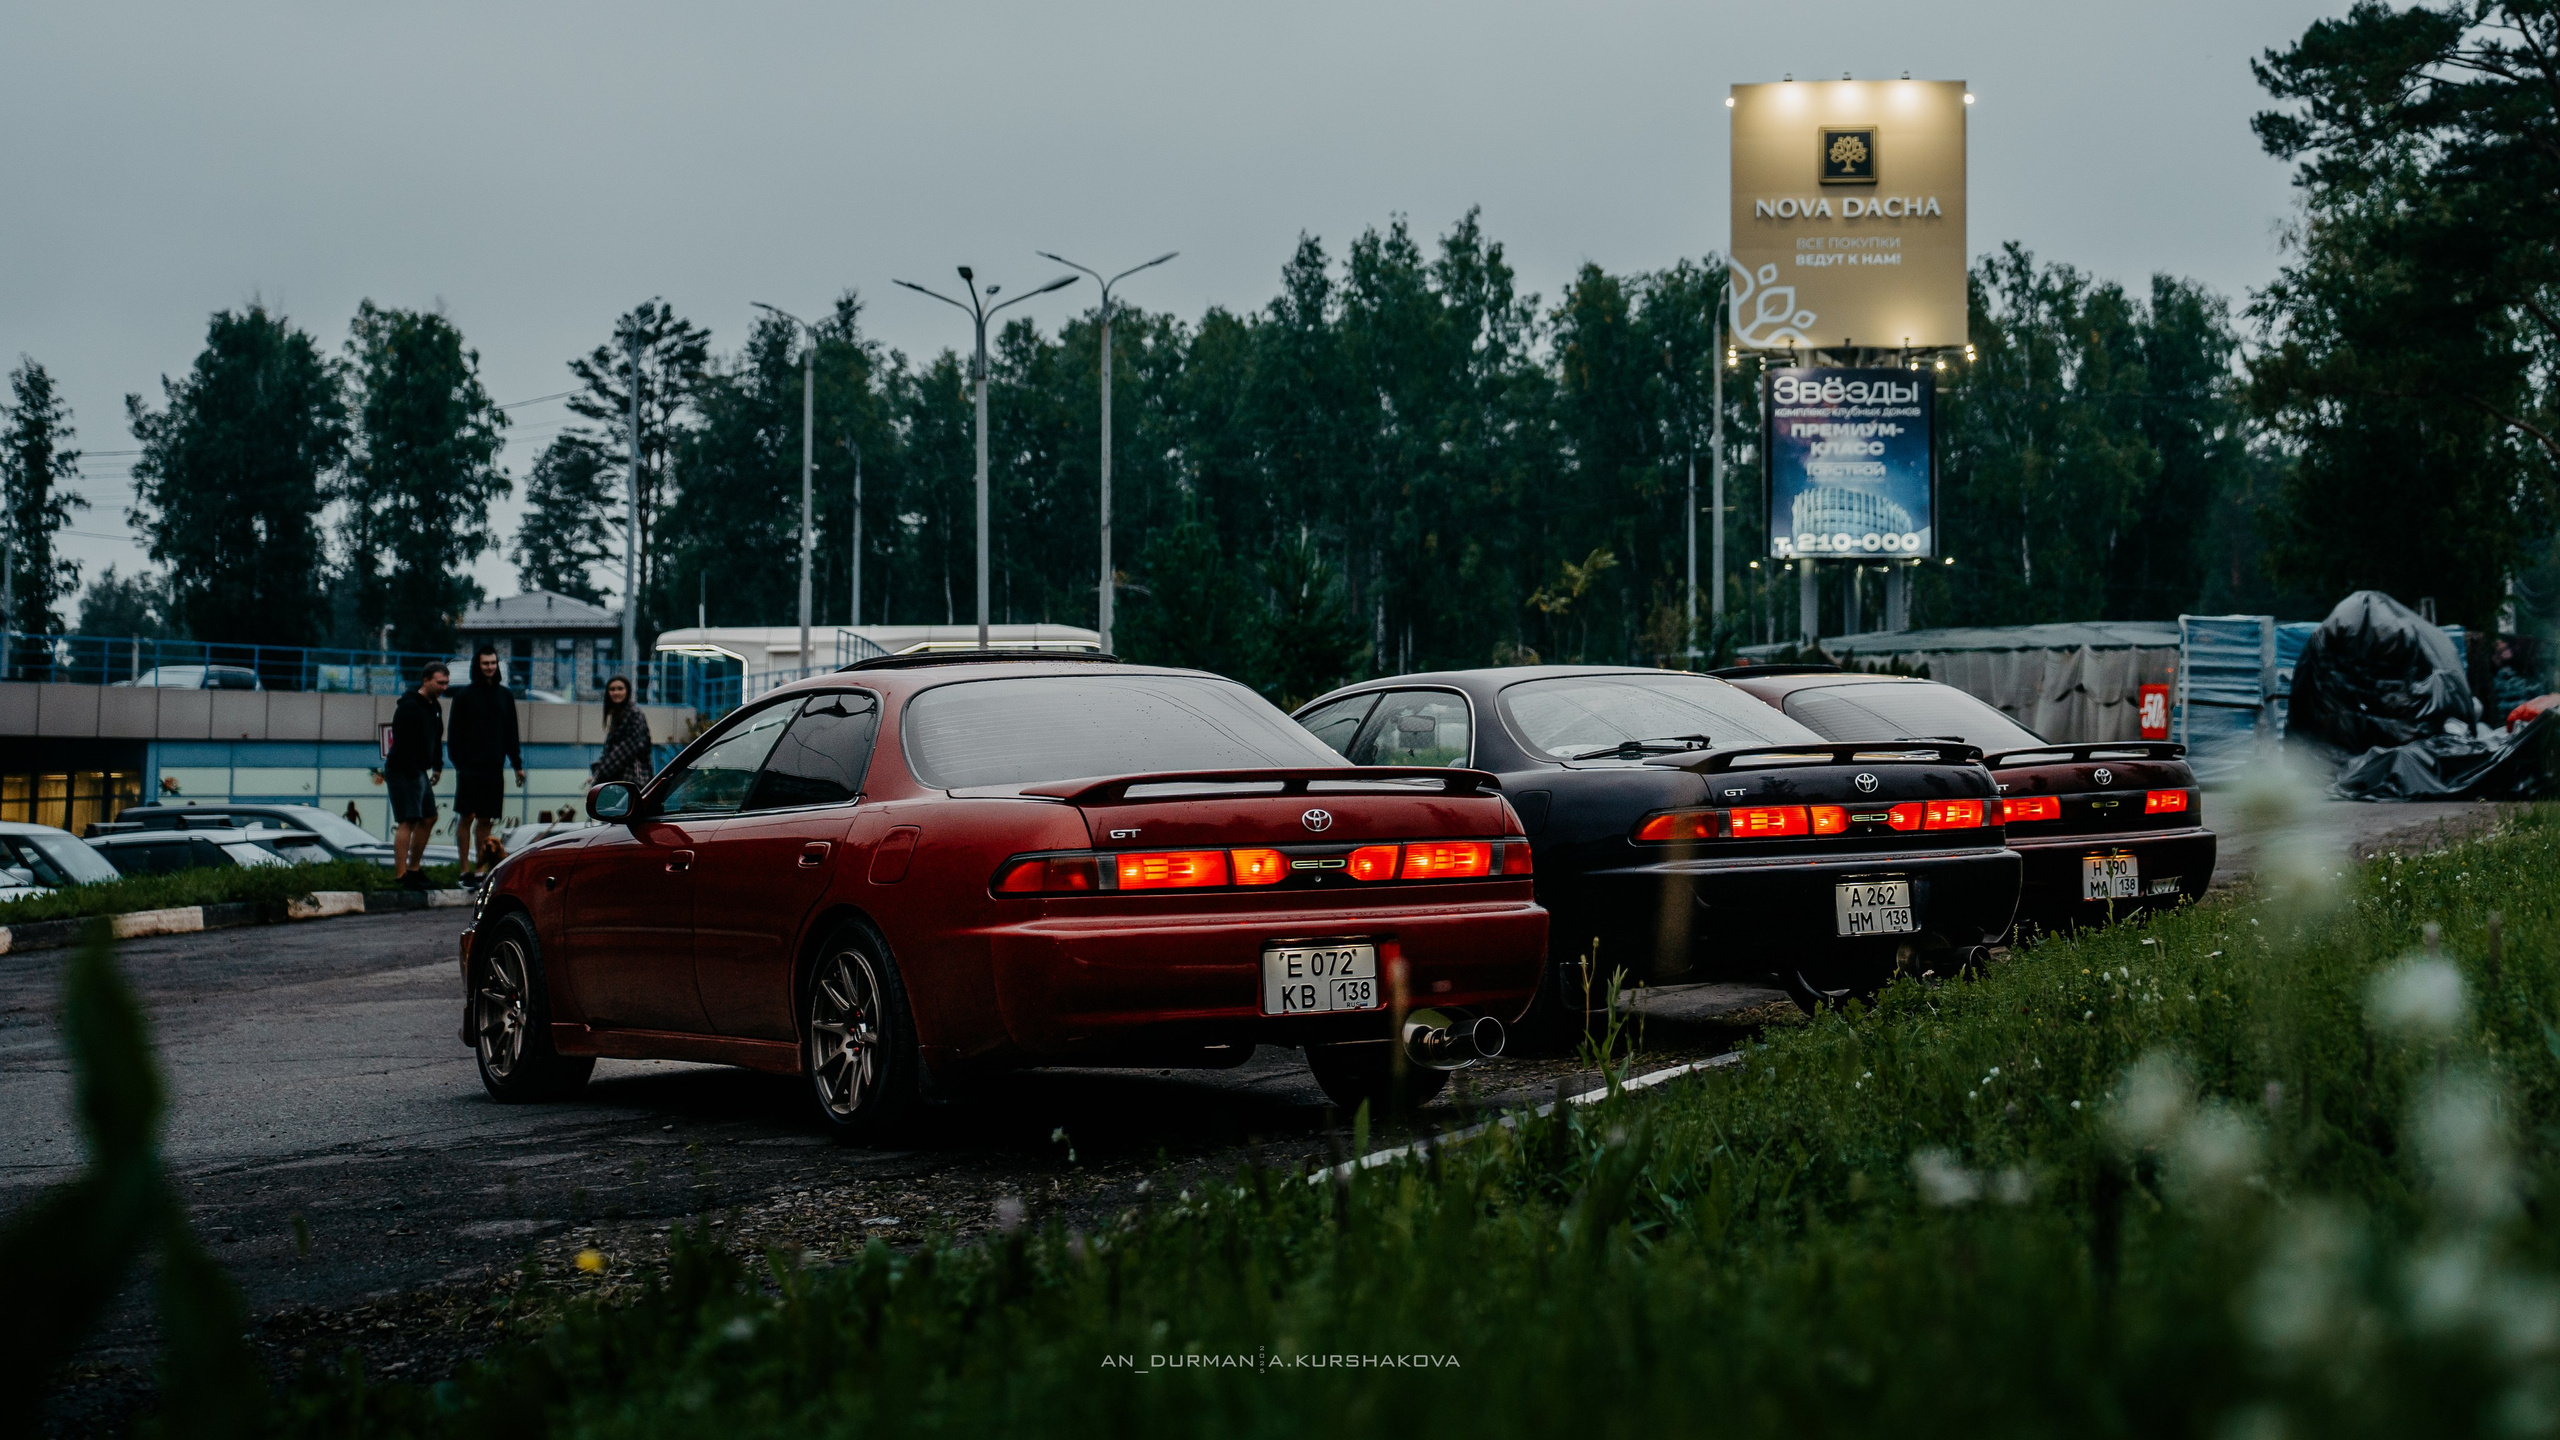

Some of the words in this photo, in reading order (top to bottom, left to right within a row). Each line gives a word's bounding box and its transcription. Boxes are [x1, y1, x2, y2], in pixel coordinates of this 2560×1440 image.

[1755, 197, 1832, 219] NOVA
[1842, 197, 1942, 218] DACHA
[1796, 237, 1824, 250] ВСЕ
[1828, 236, 1901, 250] ПОКУПКИ
[1796, 253, 1844, 267] ВЕДУТ
[1848, 253, 1858, 265] К
[1862, 253, 1902, 265] НАМ!
[1773, 376, 1918, 406] Звёзды
[1790, 421, 1905, 438] ПРЕМИУМ-
[1810, 441, 1886, 456] КЛАСС
[1796, 532, 1921, 552] 210-000
[1724, 787, 1747, 797] GT
[1109, 828, 1142, 839] GT
[2119, 878, 2135, 891] 138
[1867, 886, 1896, 906] 262
[1885, 910, 1908, 925] 138
[1311, 951, 1354, 976] 072
[1337, 981, 1371, 1002] 138
